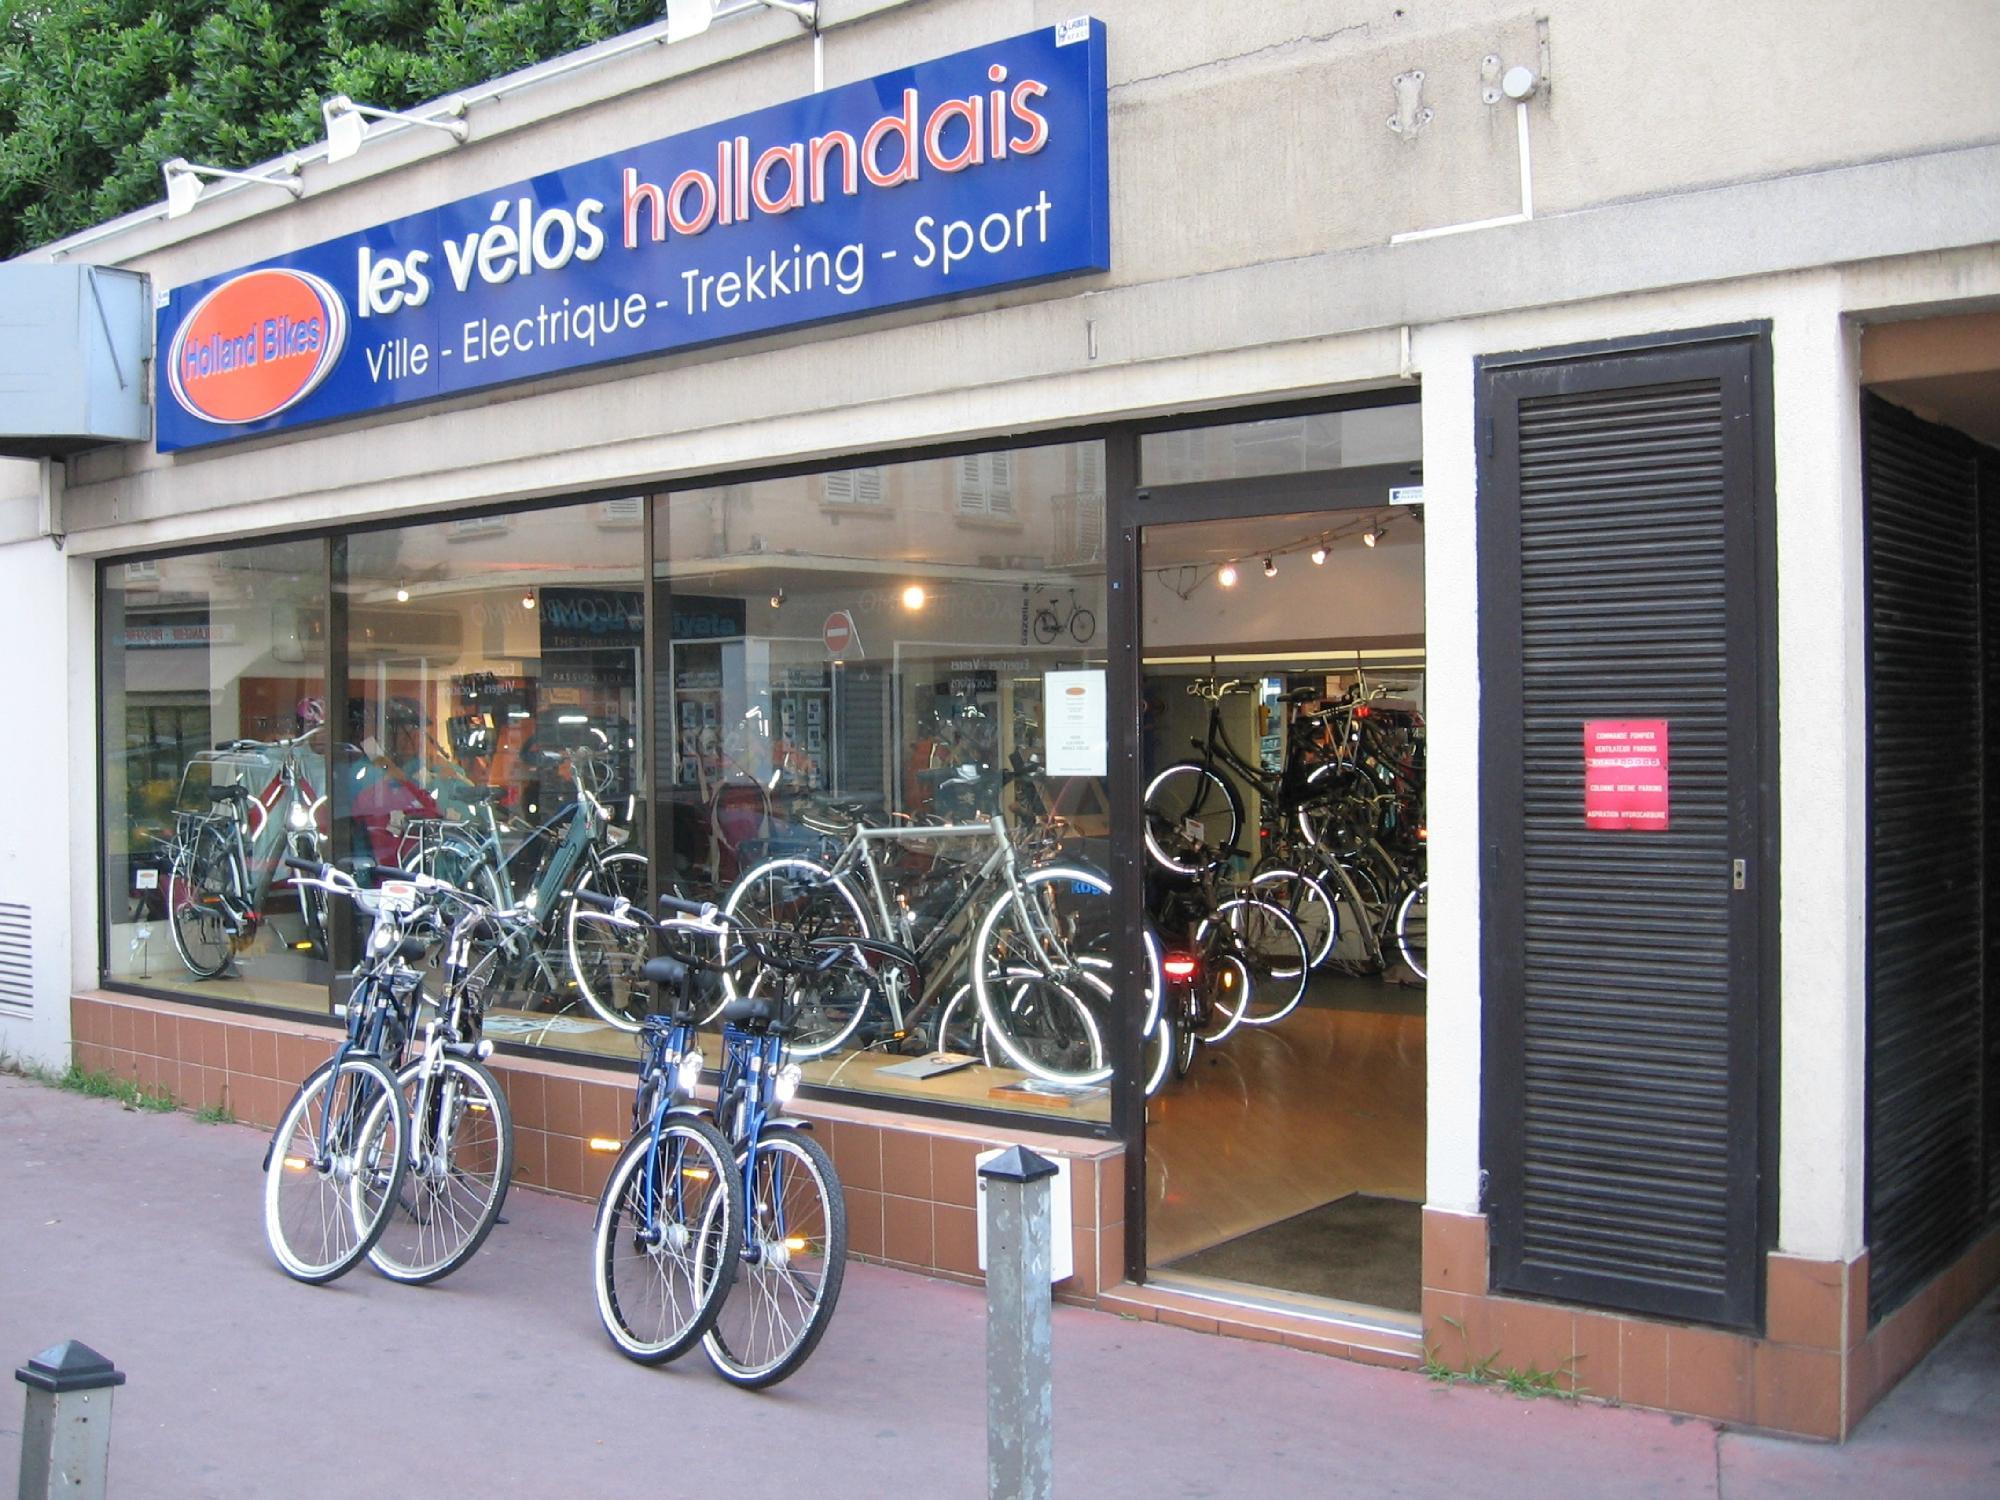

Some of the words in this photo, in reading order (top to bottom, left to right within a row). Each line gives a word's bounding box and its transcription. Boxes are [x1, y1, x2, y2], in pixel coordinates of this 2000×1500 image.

[358, 246, 430, 317] les
[443, 196, 608, 292] vélos
[623, 63, 1050, 249] hollandais
[365, 340, 429, 383] Ville
[462, 301, 646, 364] Electrique
[682, 242, 864, 315] Trekking
[913, 190, 1052, 275] Sport
[186, 323, 258, 381] Holland
[263, 314, 321, 363] Bikes
